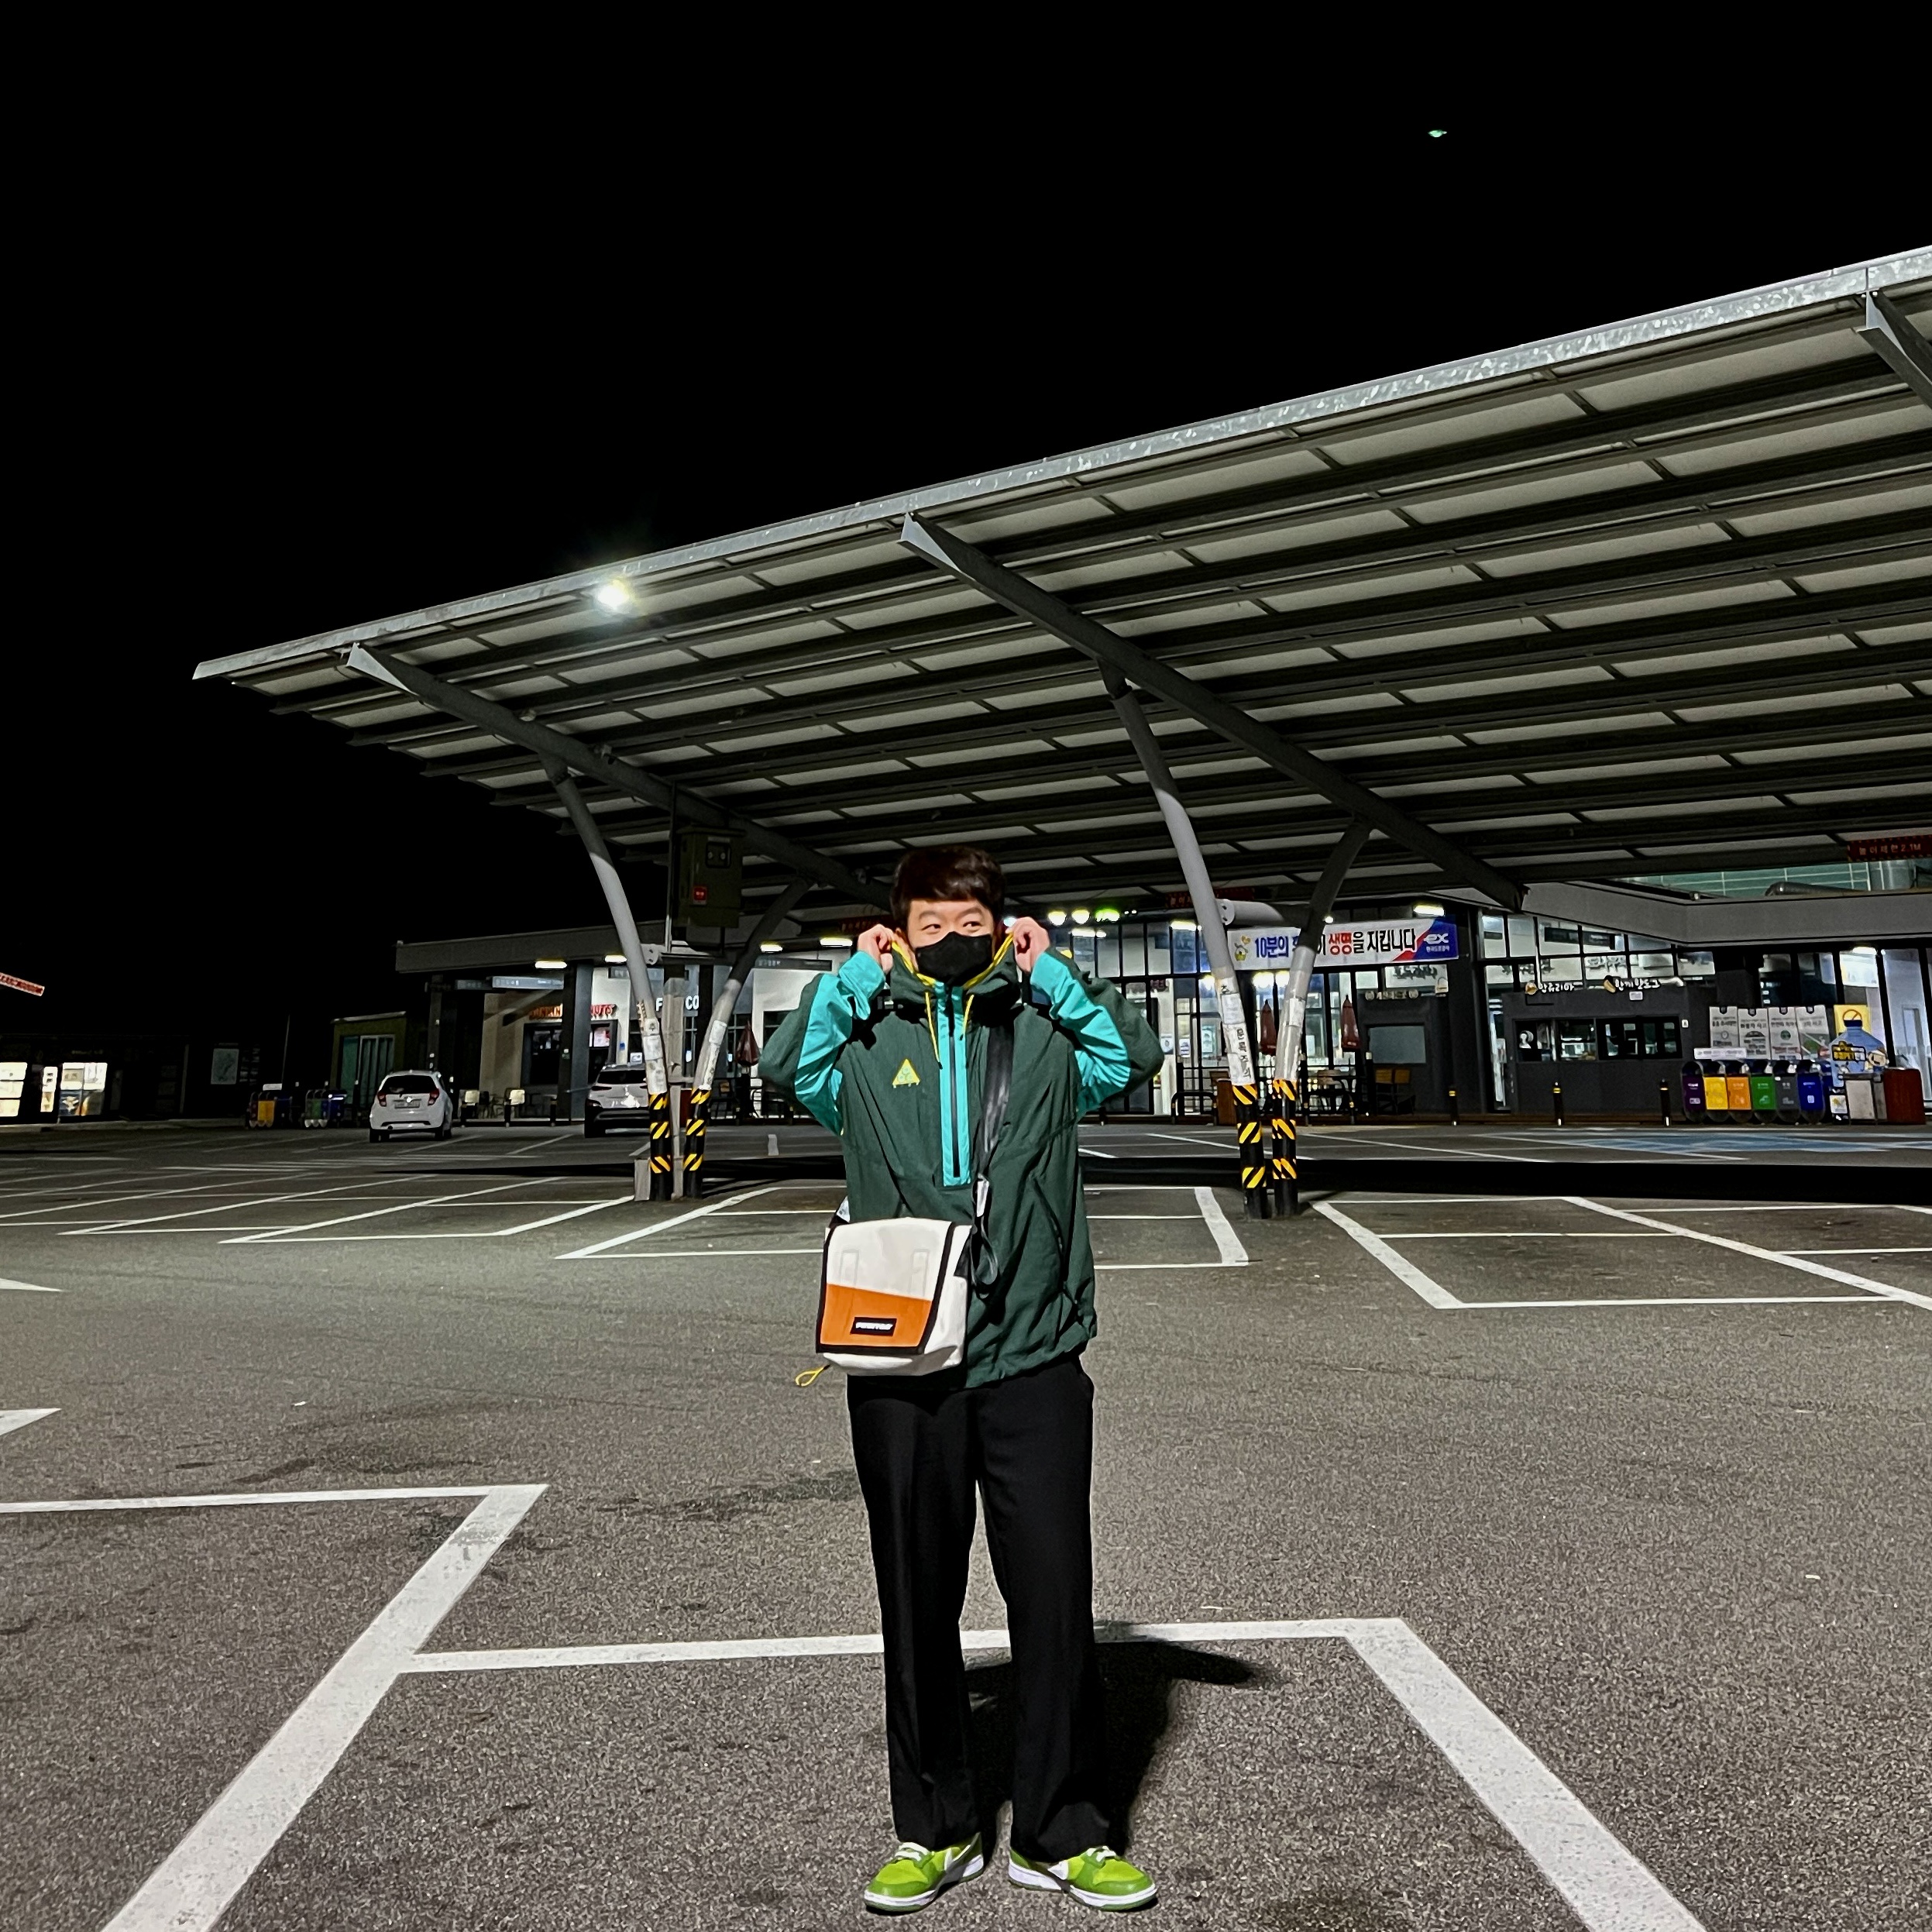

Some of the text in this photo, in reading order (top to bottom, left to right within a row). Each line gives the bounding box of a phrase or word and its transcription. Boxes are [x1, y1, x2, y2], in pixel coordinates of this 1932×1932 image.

[1255, 936, 1289, 957] 10분의
[1329, 930, 1365, 956] 생명을
[1366, 927, 1417, 953] 지킵니다
